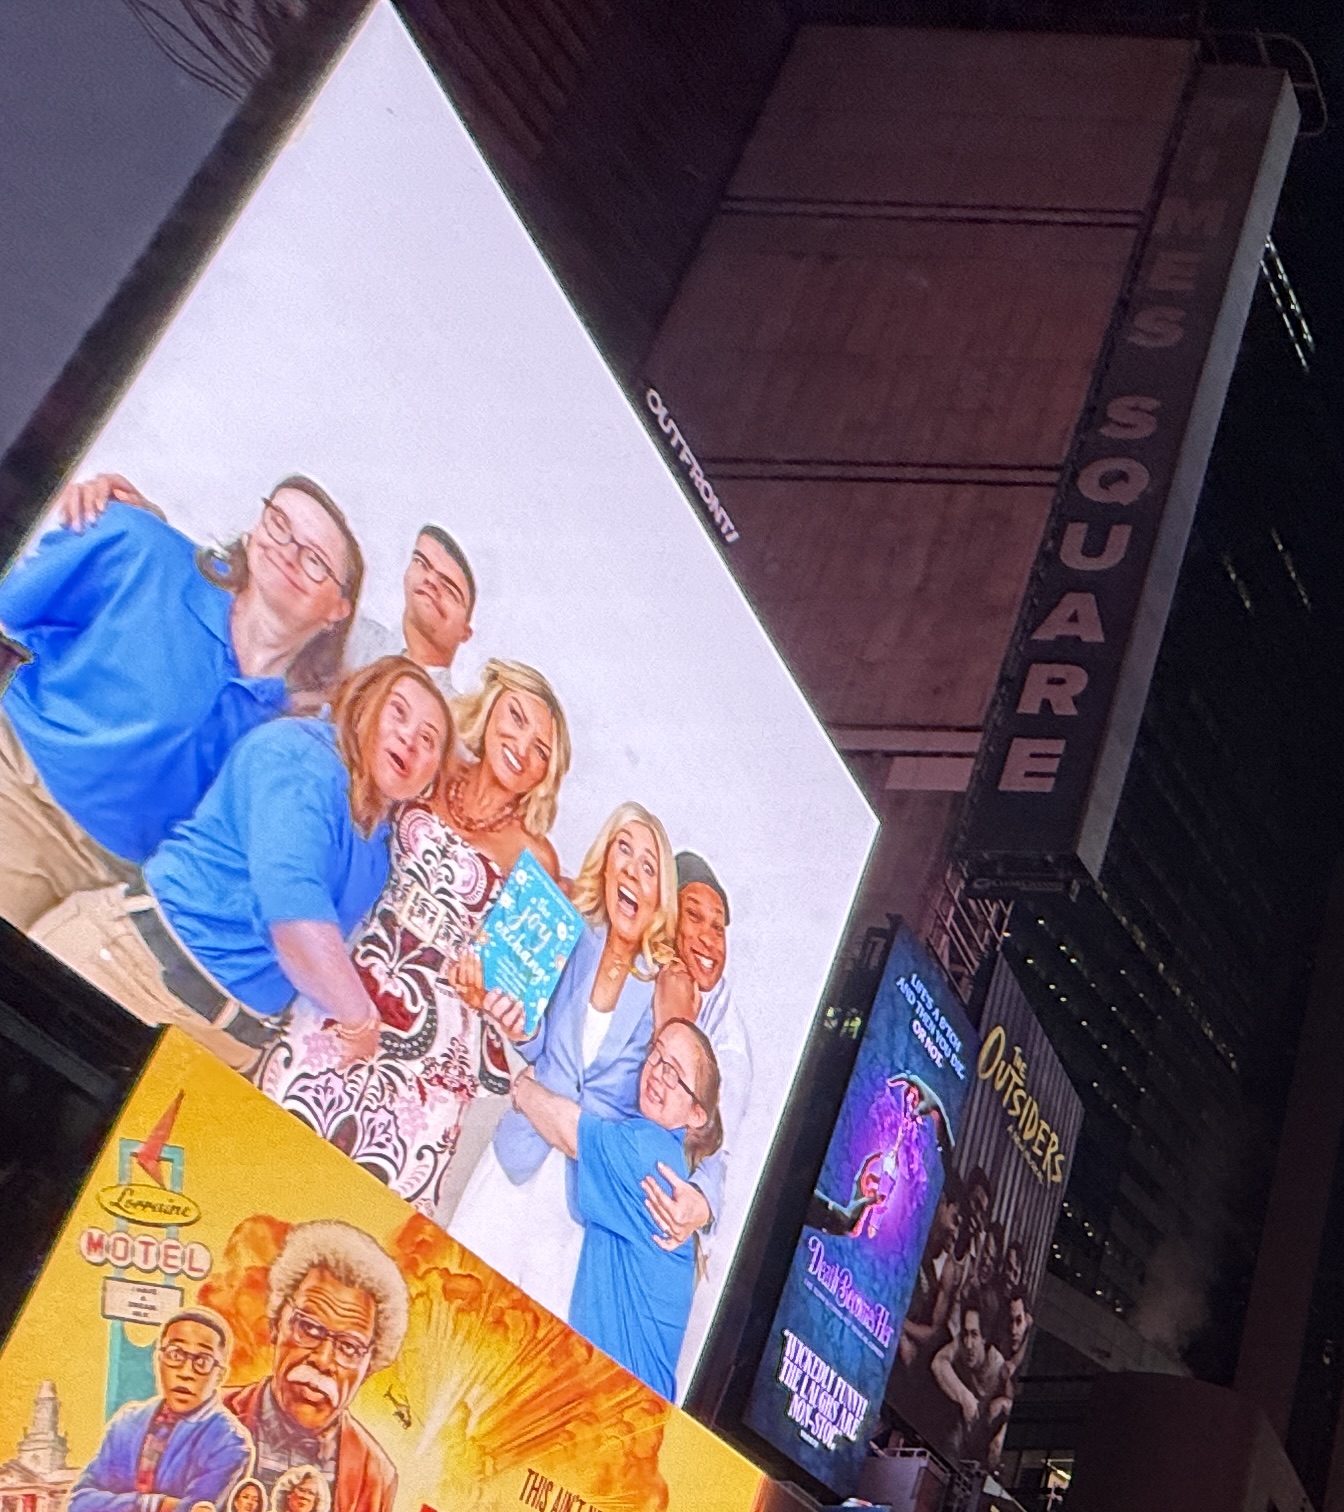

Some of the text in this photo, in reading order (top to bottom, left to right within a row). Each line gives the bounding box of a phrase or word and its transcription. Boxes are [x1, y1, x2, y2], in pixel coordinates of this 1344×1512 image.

[999, 395, 1158, 793] SQUARE
[495, 921, 549, 985] exchange
[506, 906, 553, 953] joy
[896, 977, 916, 1005] AND
[915, 1000, 936, 1035] THEN
[936, 1029, 951, 1058] YOU
[912, 1019, 926, 1043] OR
[1013, 1046, 1027, 1080] THE
[977, 1025, 1064, 1189] OUTSIDERS
[110, 1188, 191, 1218] Lorraine
[86, 1231, 205, 1273] MOTEL
[808, 1236, 840, 1295] Death
[837, 1268, 876, 1334] Becomes
[874, 1303, 894, 1348] Her
[780, 1358, 802, 1394] THE
[800, 1376, 839, 1427] LAUGHS
[837, 1409, 859, 1441] ARE
[519, 1467, 554, 1512] THIS
